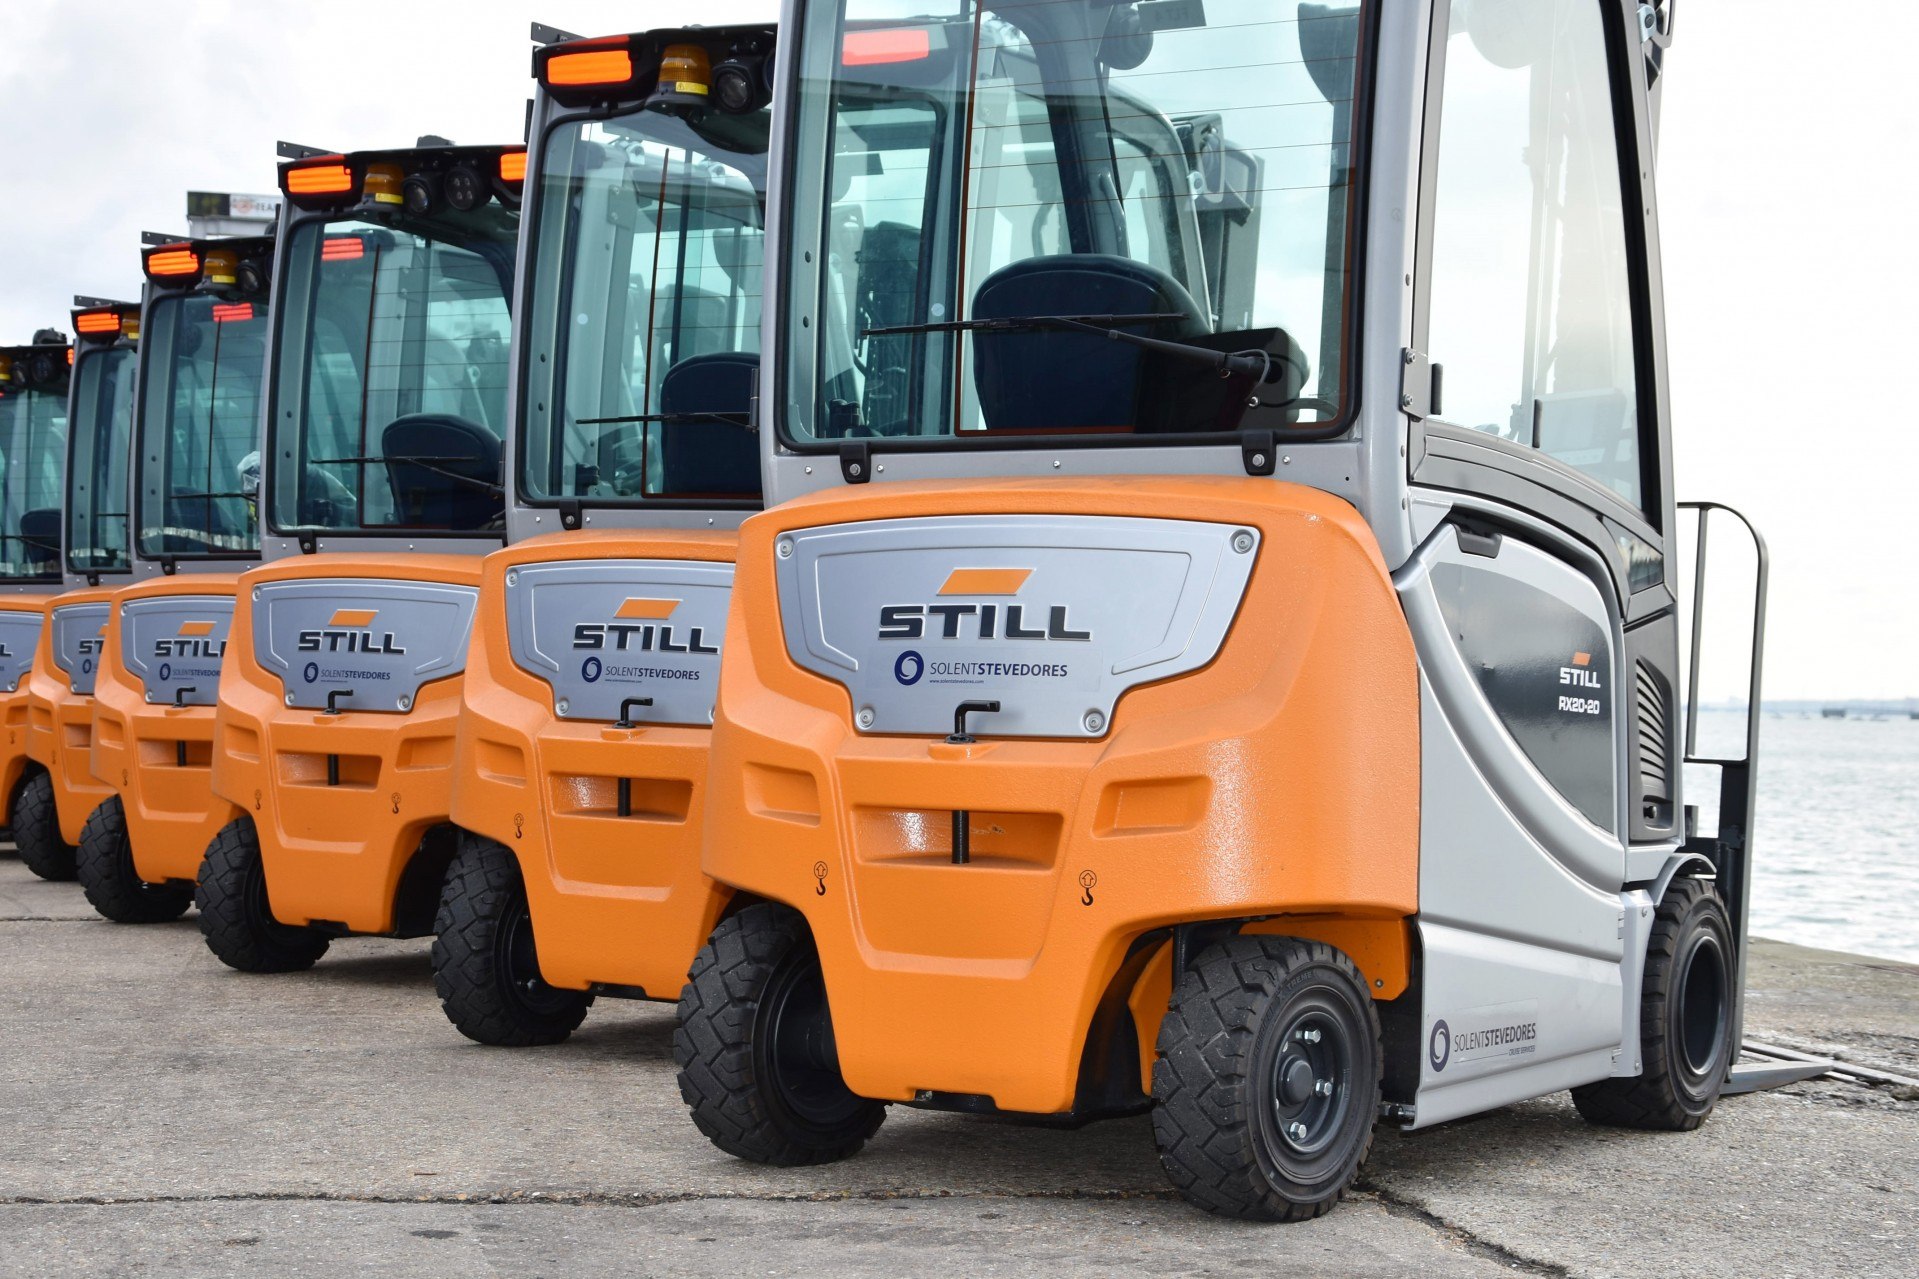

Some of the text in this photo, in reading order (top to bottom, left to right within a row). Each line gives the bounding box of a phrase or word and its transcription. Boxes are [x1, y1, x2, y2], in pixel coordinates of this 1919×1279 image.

[878, 604, 1091, 641] STILL
[298, 630, 406, 655] STILL
[573, 623, 720, 654] STILL
[321, 669, 391, 681] SOLENTSTEVEDORES
[605, 665, 700, 681] SOLENTSTEVEDORES
[930, 662, 1068, 677] SOLENTSTEVEDORES
[1559, 667, 1601, 688] STILL
[1558, 696, 1600, 715] RX20-20
[1454, 1023, 1536, 1053] SOLENTSTEVEDORES
